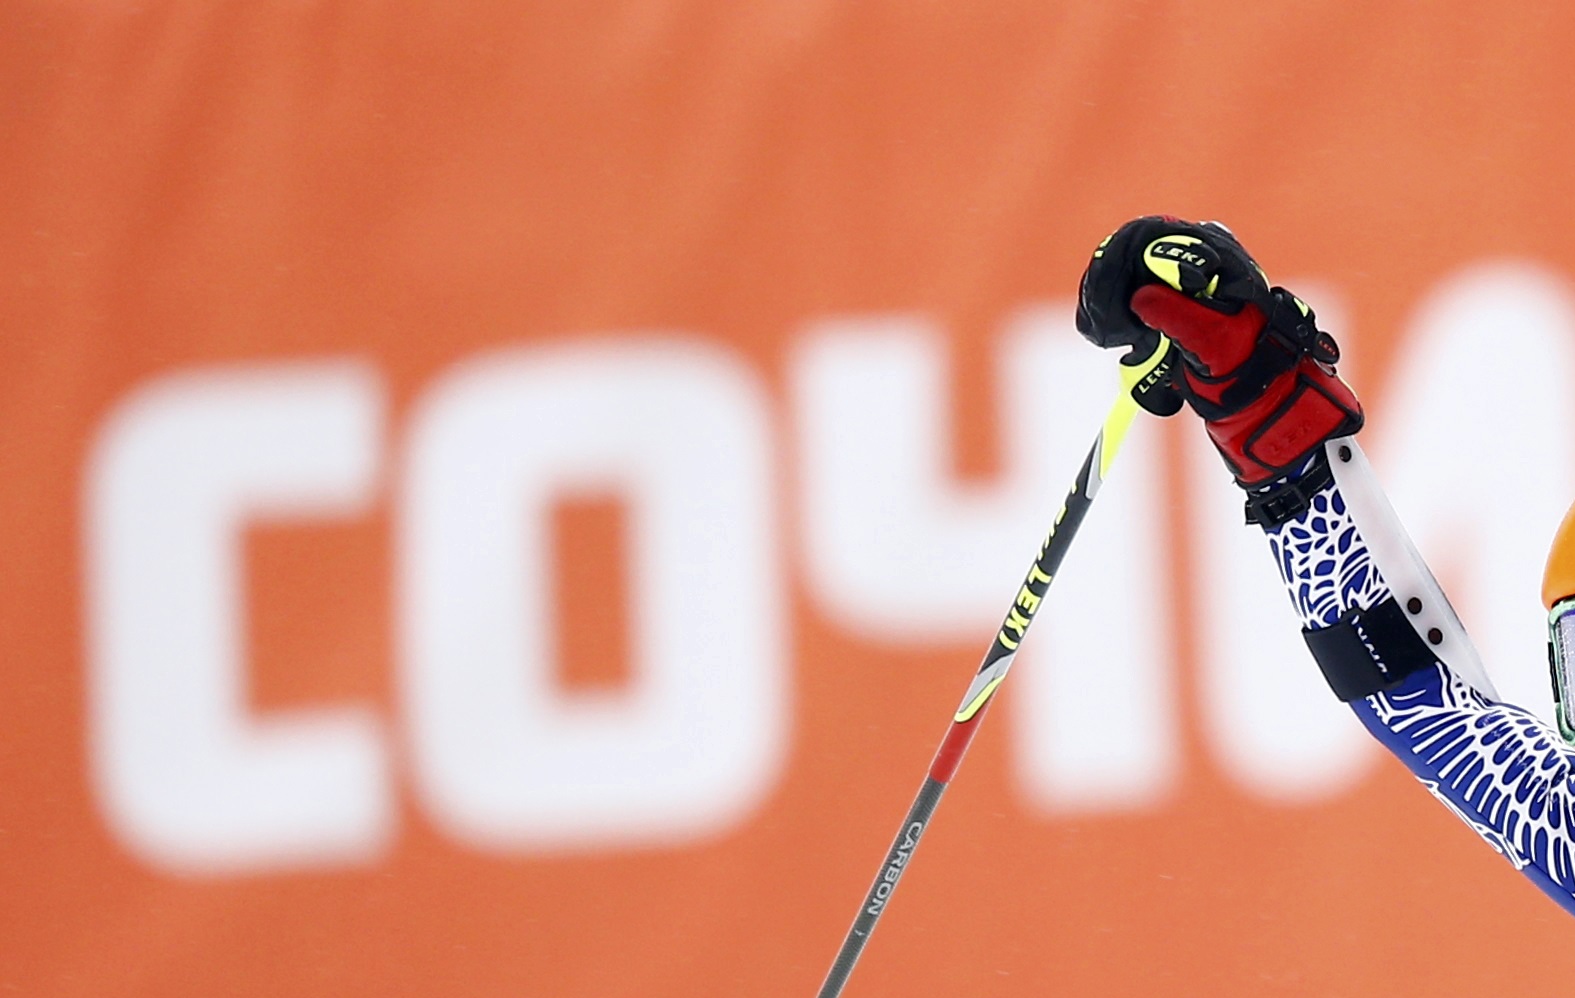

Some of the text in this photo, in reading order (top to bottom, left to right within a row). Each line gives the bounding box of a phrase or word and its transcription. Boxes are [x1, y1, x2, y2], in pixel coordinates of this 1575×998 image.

[1153, 245, 1206, 267] LEKI
[1138, 362, 1169, 394] LEKI
[1000, 562, 1052, 650] LEKI
[867, 821, 923, 916] CARBON
